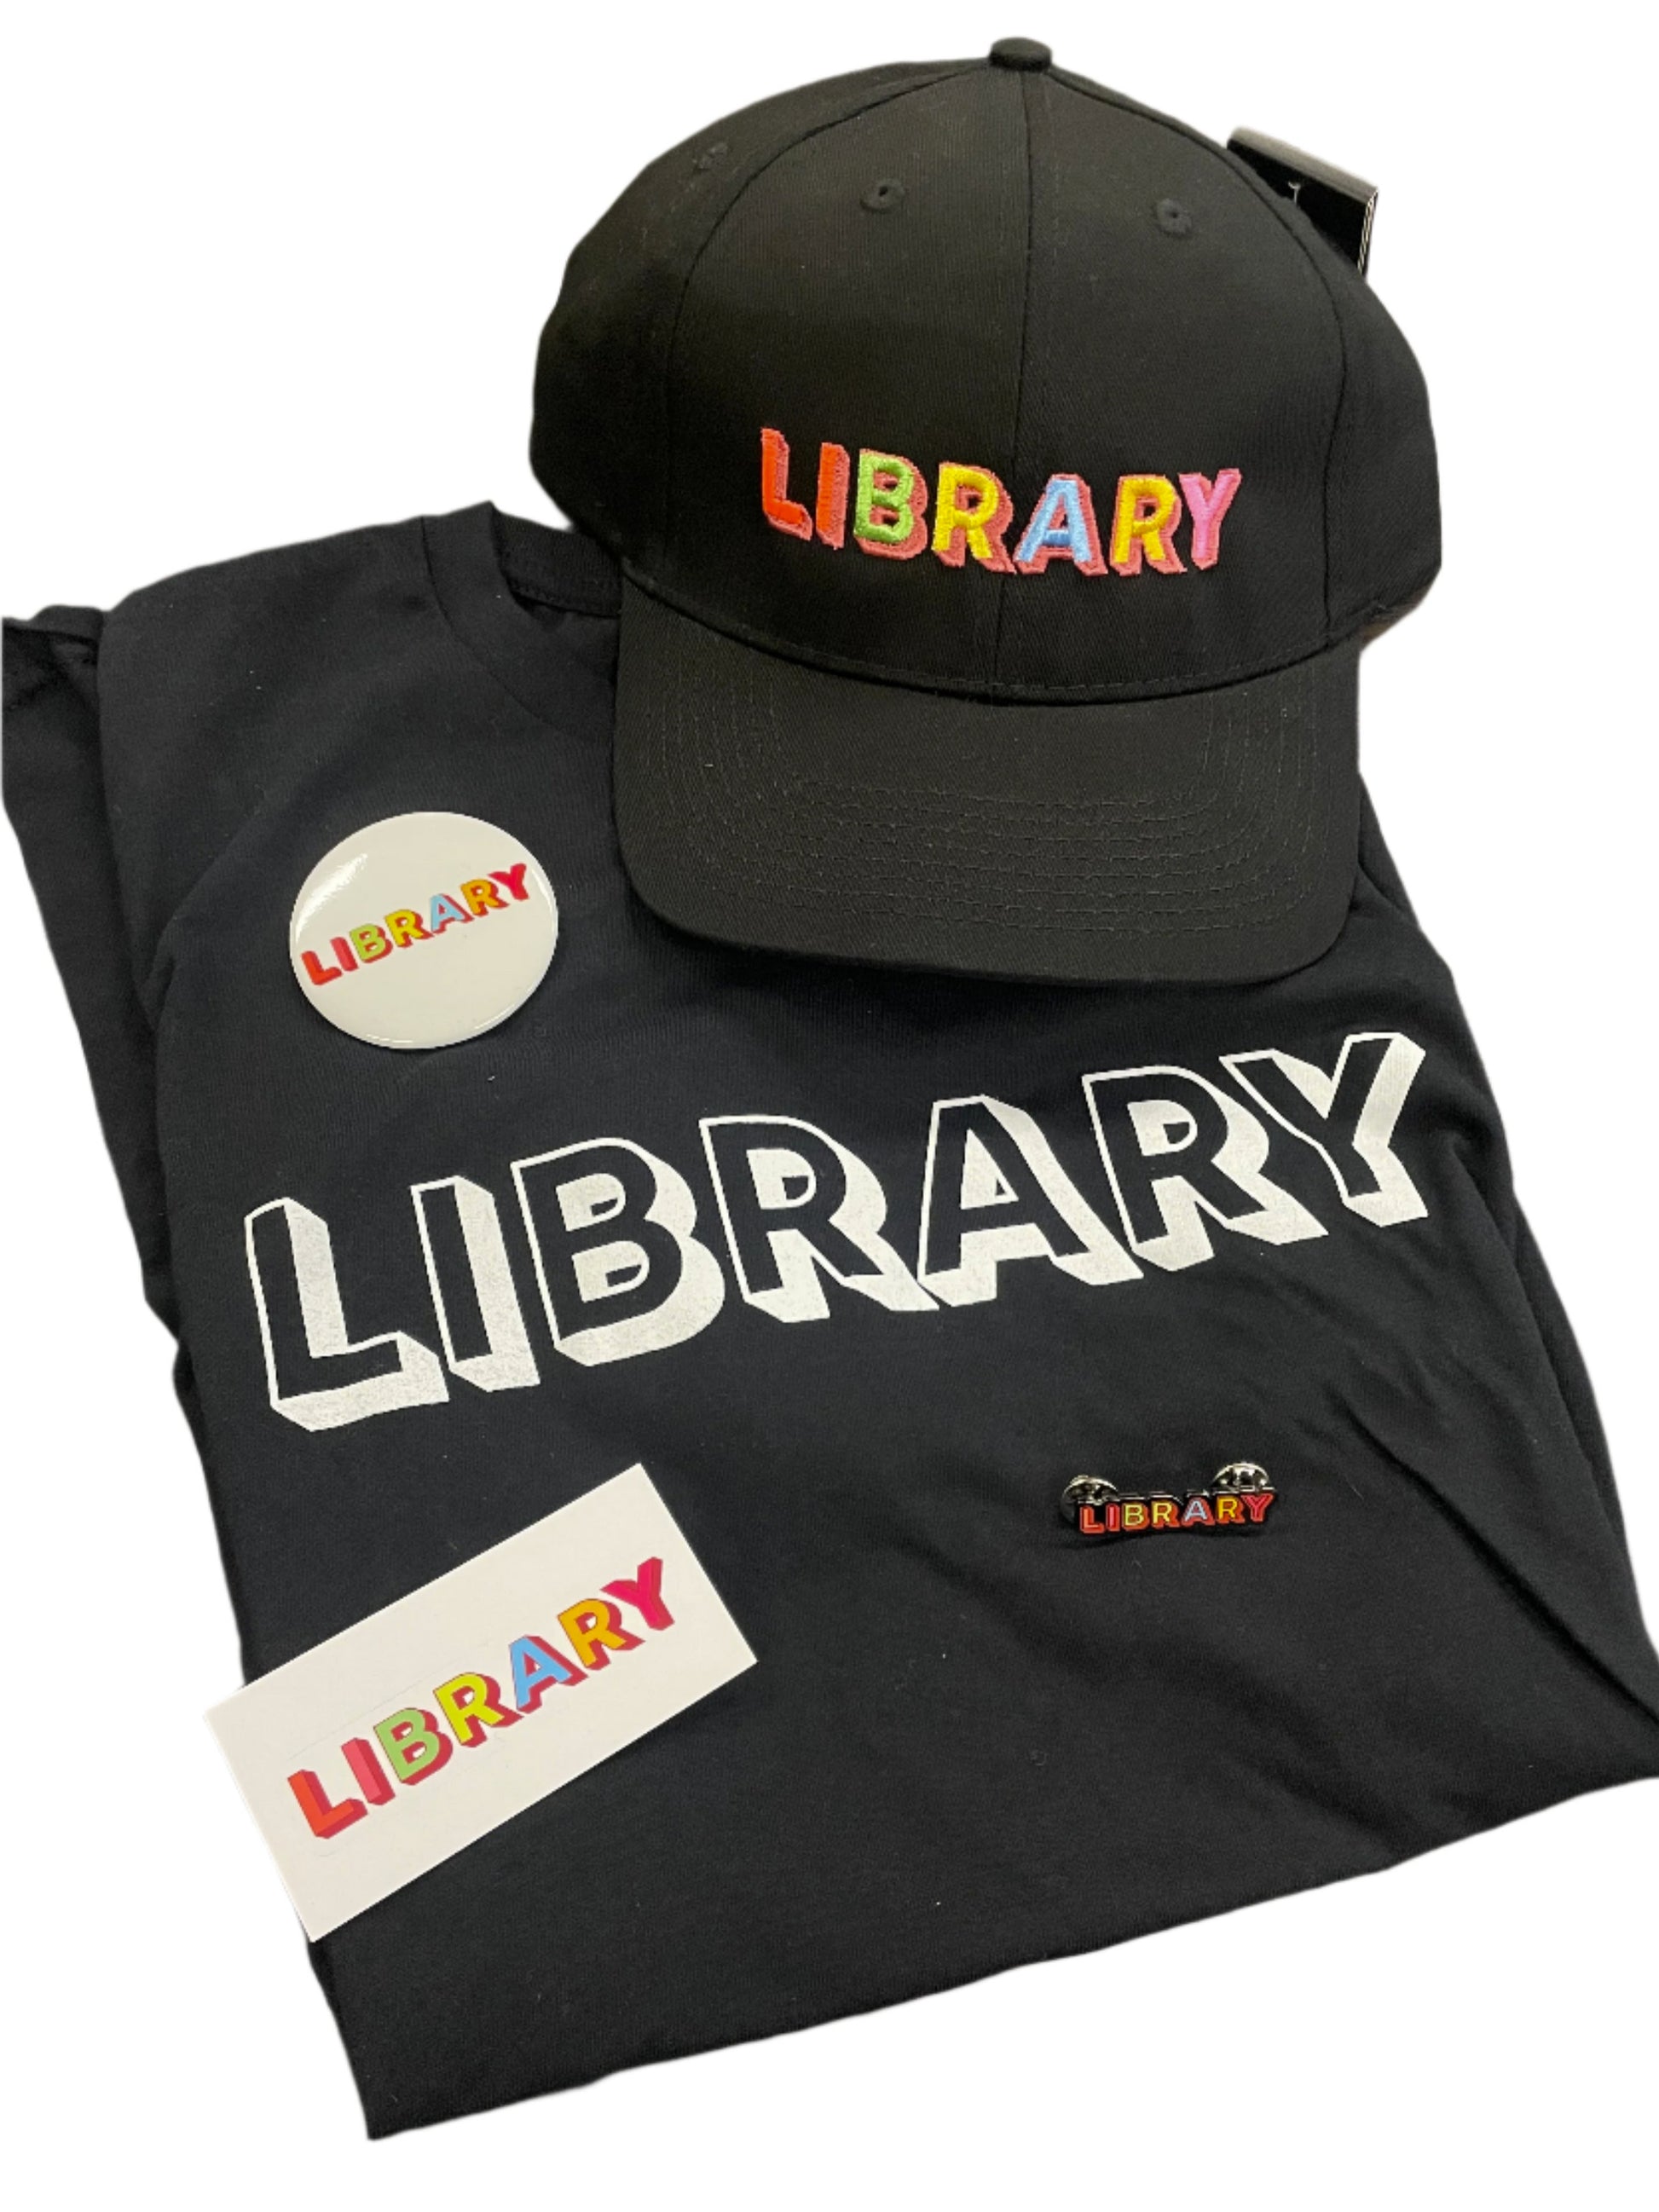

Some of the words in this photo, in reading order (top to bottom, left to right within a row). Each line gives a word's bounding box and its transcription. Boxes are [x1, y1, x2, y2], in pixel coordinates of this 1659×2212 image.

[760, 427, 1242, 576] LIBRARY
[300, 863, 530, 986] LIBRARY
[244, 1031, 1430, 1432] LIBRARY
[1079, 1493, 1275, 1534] LIBRARY
[286, 1556, 675, 1839] LIBRARY
